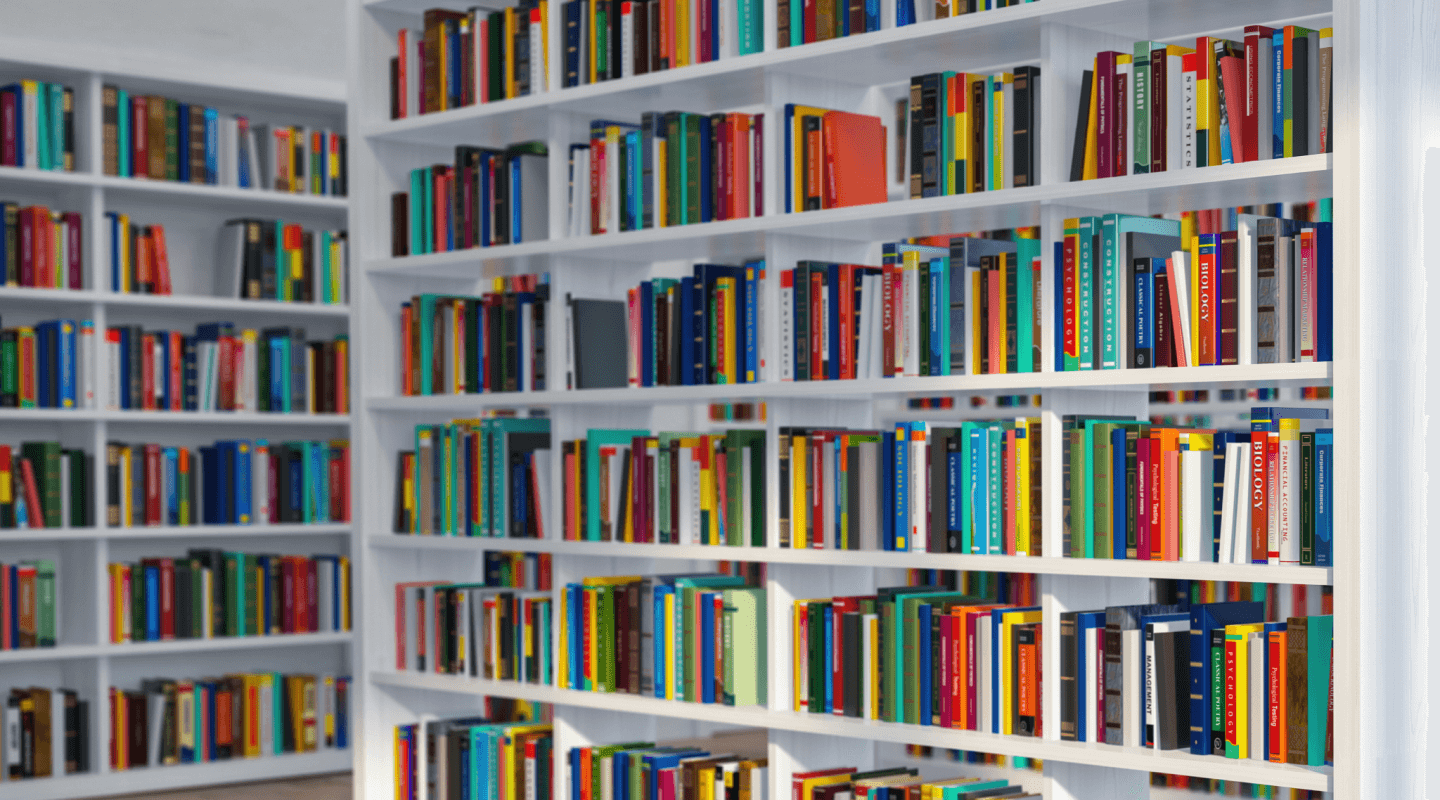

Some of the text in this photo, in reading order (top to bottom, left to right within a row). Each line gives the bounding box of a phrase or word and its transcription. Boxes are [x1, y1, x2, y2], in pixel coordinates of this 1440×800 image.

[1136, 72, 1144, 110] HISTORY
[1065, 248, 1073, 345] PSYCHOLOGY
[1200, 262, 1209, 322] BIOLOGY
[1253, 441, 1263, 511] BIOLOGY
[1151, 503, 1159, 524] Testing
[1270, 706, 1278, 726] Testing
